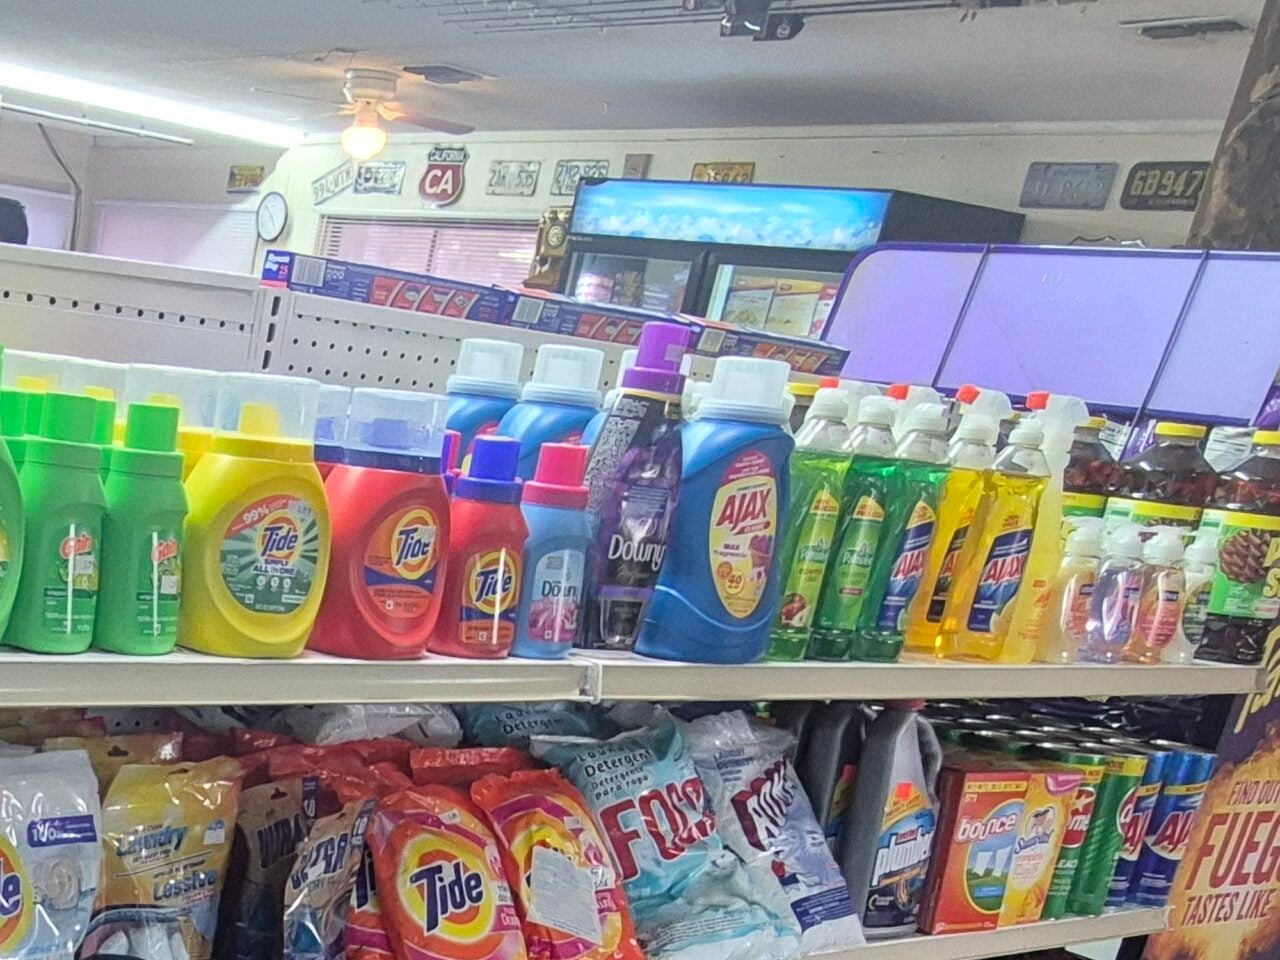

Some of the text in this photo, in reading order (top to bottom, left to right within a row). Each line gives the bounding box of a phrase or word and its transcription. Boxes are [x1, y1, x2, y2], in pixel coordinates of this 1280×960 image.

[425, 170, 453, 194] CA
[1130, 170, 1208, 196] 6B947
[242, 505, 270, 524] 99%
[716, 487, 772, 532] AJAX
[260, 524, 299, 557] Tide
[608, 534, 667, 572] Downy
[984, 555, 1025, 584] AJAX
[474, 566, 513, 603] Tide
[584, 749, 654, 777] Detergent
[591, 766, 645, 790] Detergente
[594, 775, 648, 800] para ropa
[1227, 780, 1257, 805] FIND
[354, 818, 367, 835] 10
[955, 813, 1017, 841] bounce
[1184, 811, 1280, 891] FUEG
[409, 859, 483, 935] Tide
[1182, 888, 1276, 926] TASTES LIKE
